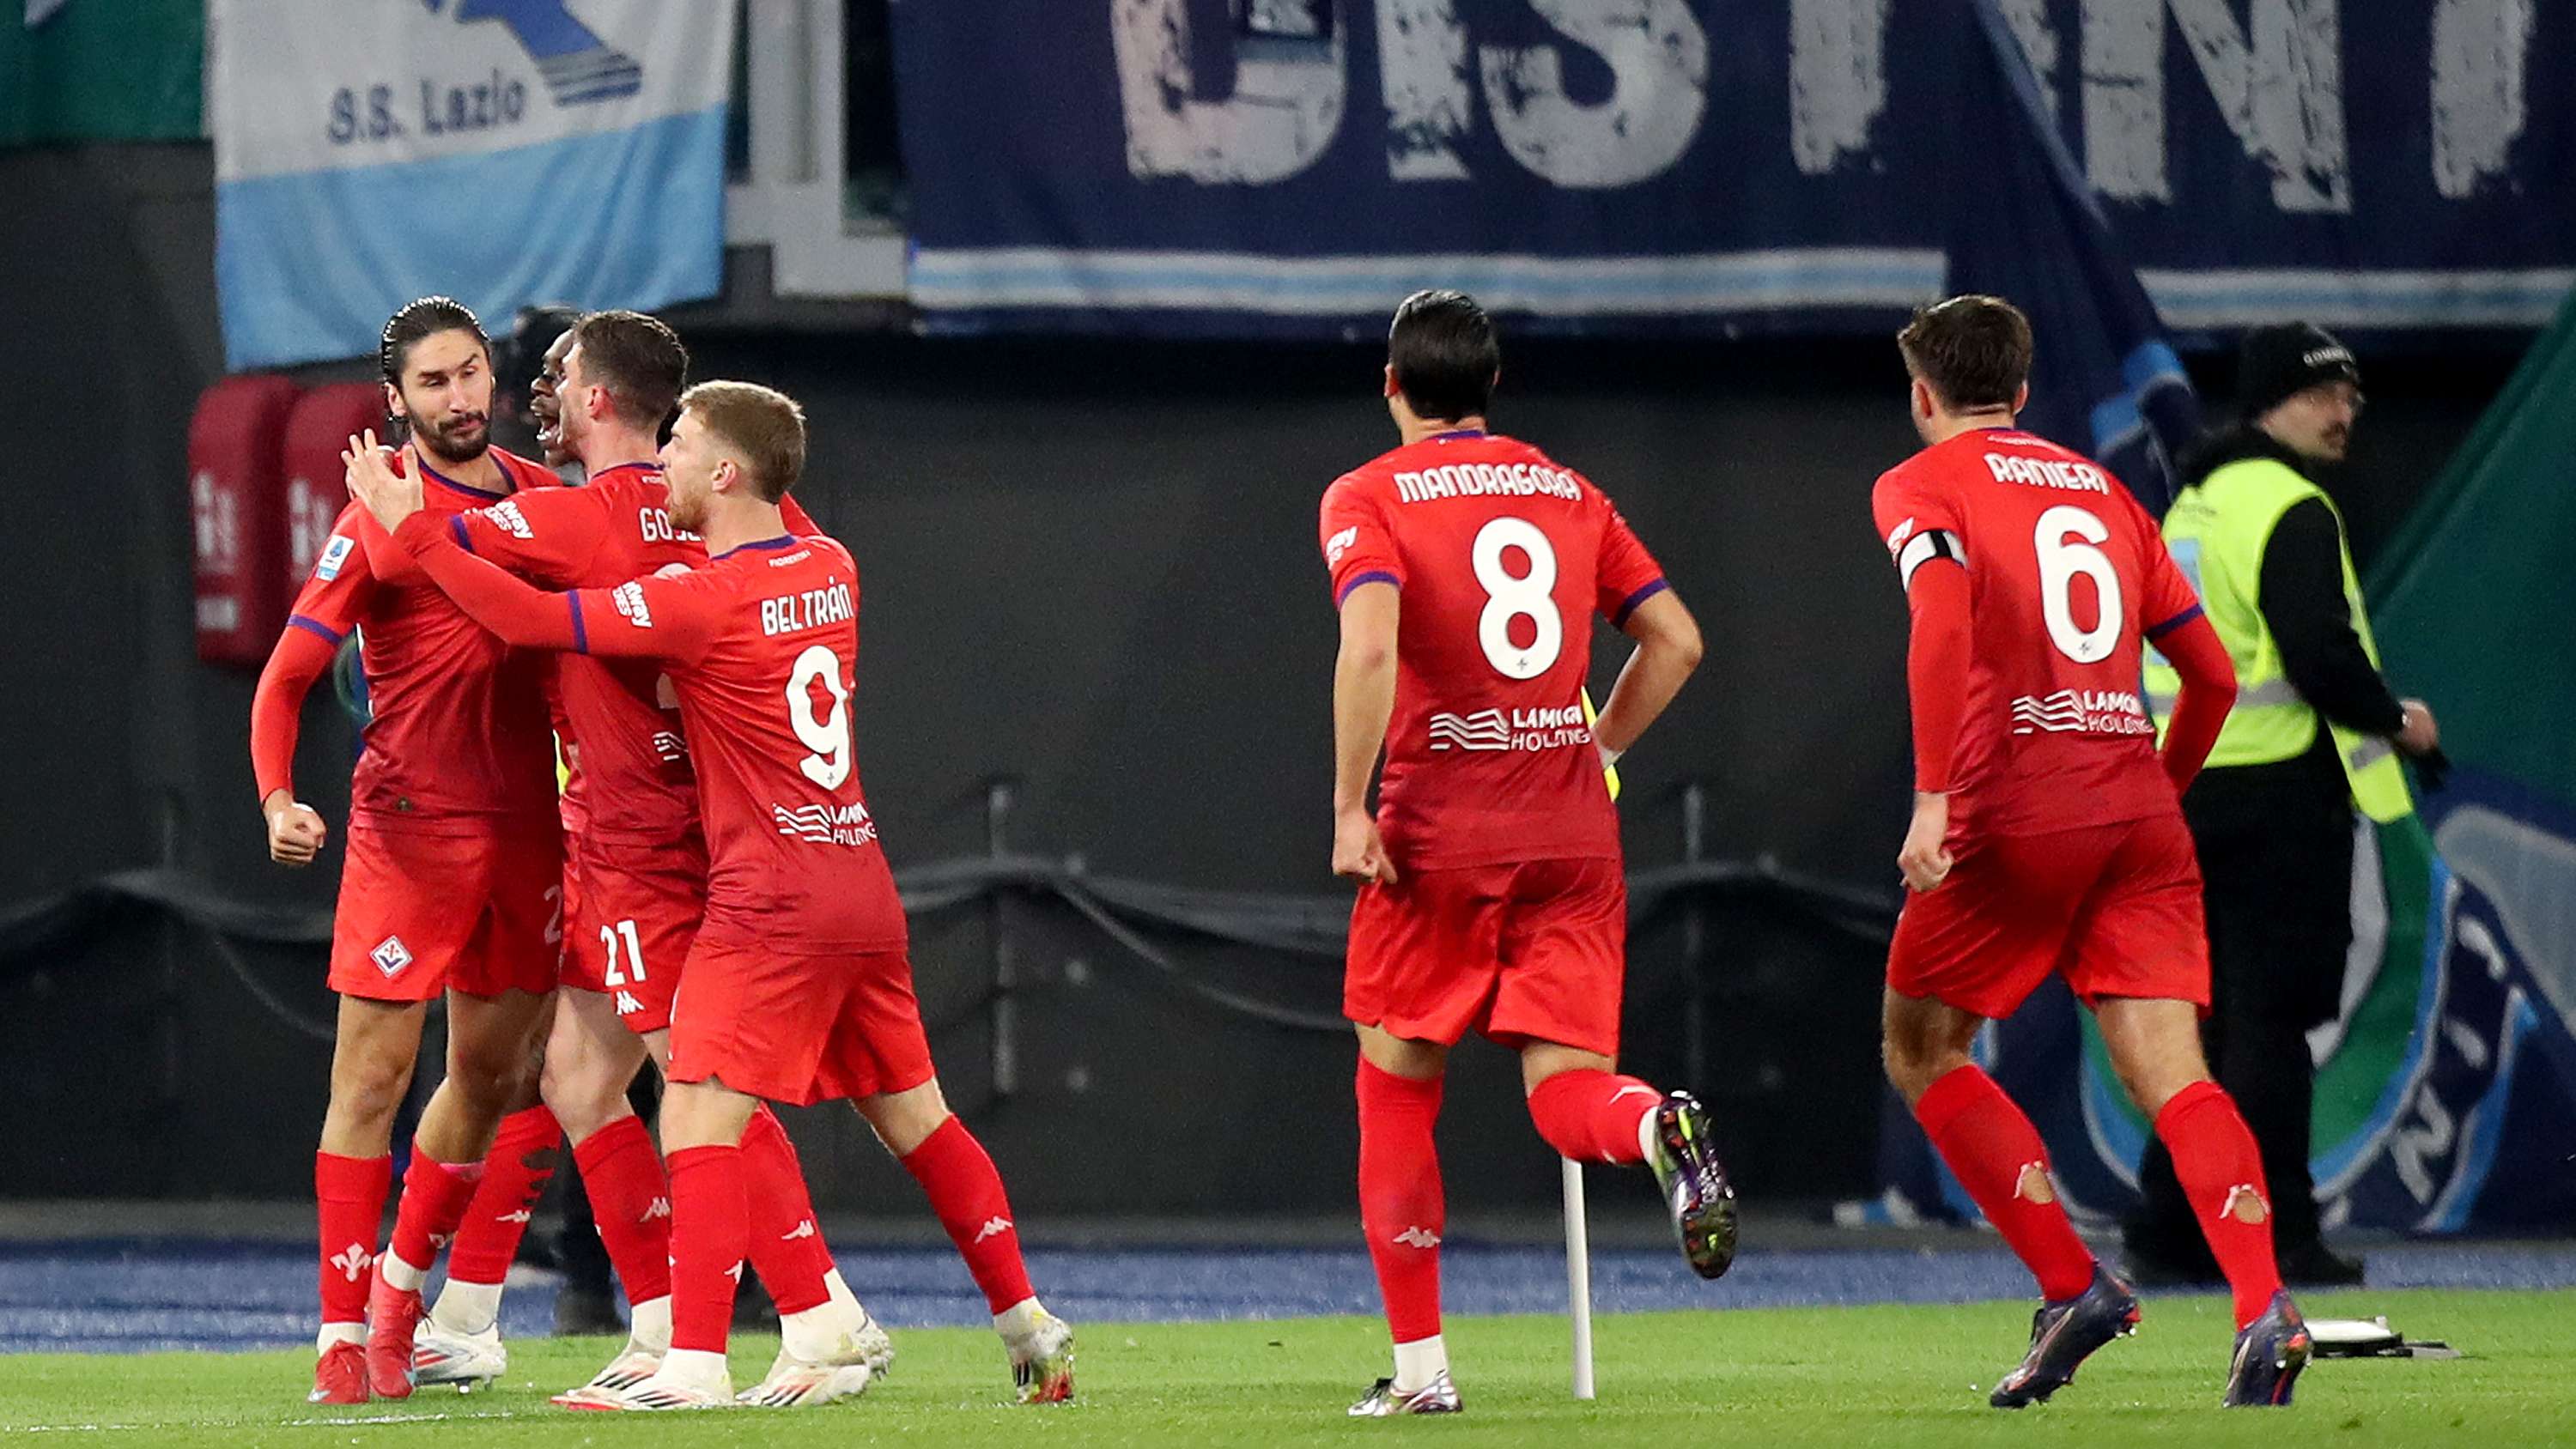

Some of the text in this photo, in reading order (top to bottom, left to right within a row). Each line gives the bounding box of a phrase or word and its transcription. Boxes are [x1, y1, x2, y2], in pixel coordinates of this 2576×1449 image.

[329, 67, 526, 144] S.S. Lazio
[1393, 463, 1583, 503] MANDRAGORA
[1984, 452, 2111, 495] RANIERI
[761, 576, 854, 636] BELTRÁN
[1472, 516, 1563, 680] 8
[2034, 504, 2124, 664] 6
[786, 645, 851, 791] 9
[600, 919, 647, 986] 21
